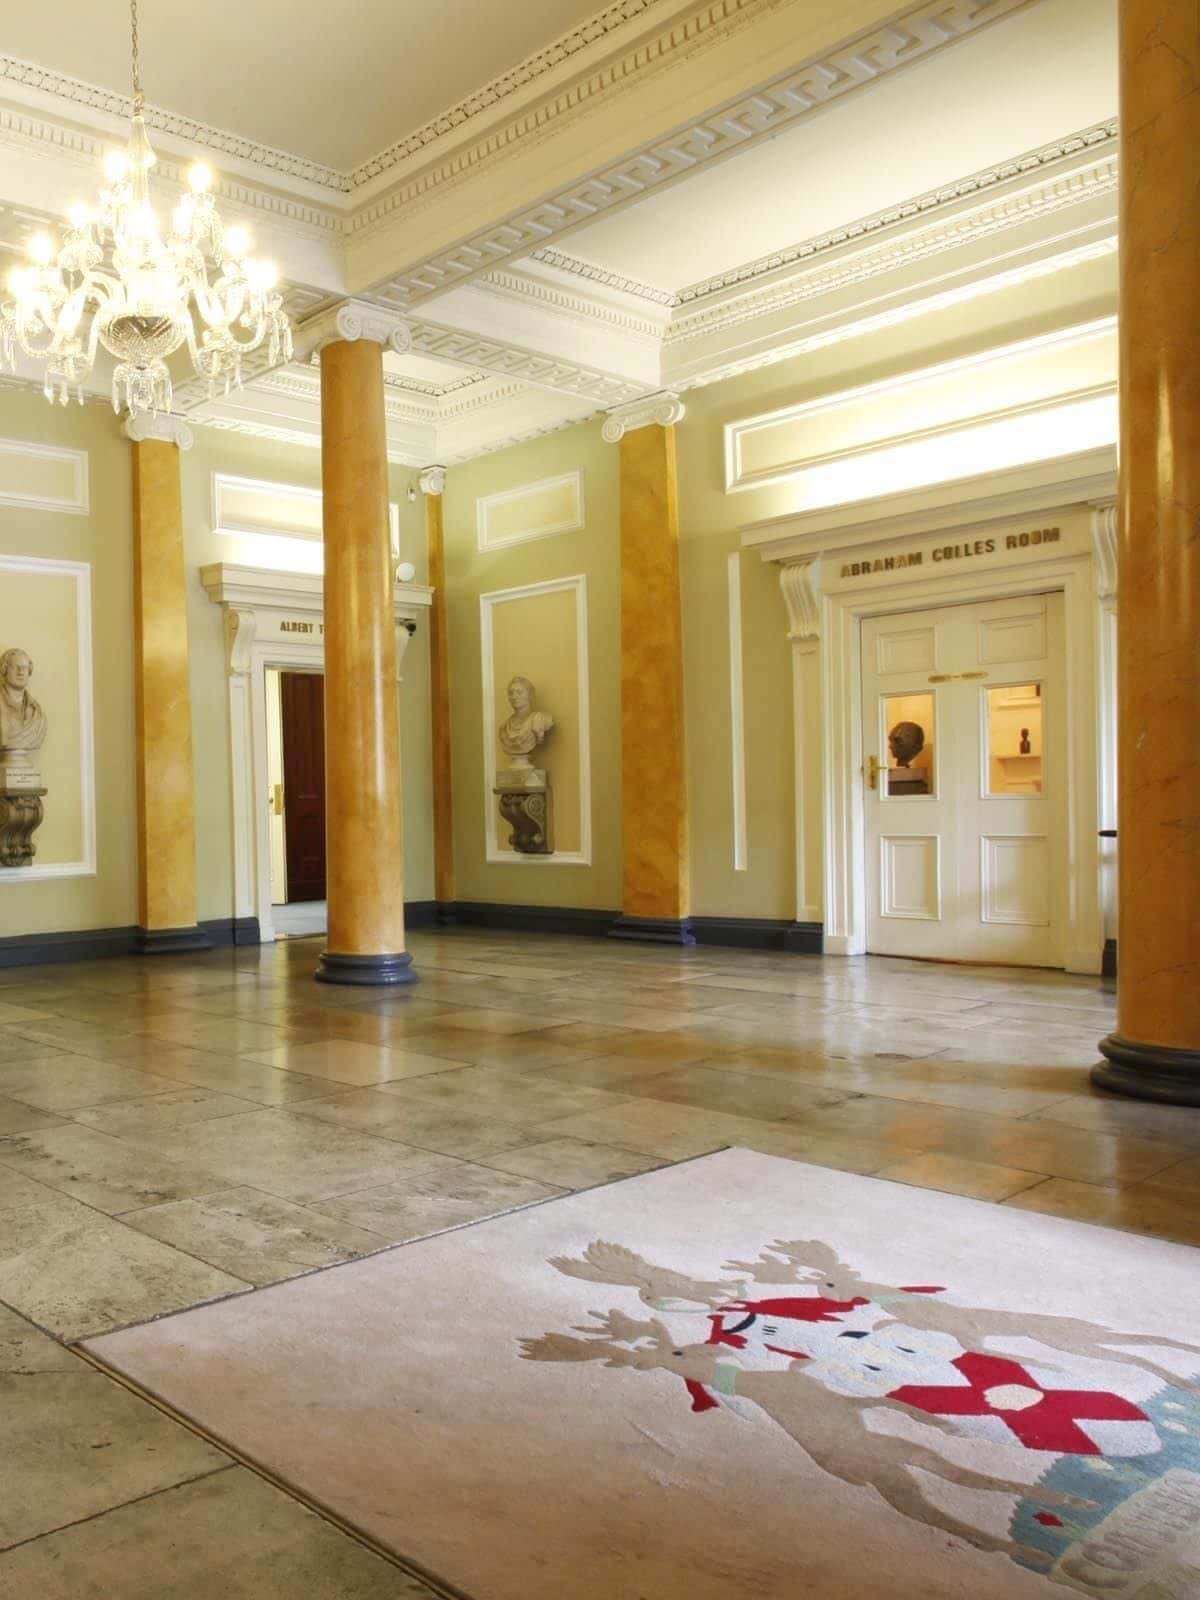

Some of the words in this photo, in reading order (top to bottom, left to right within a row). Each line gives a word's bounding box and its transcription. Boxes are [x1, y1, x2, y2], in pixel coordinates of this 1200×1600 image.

[840, 551, 923, 578] ABRAHAM
[932, 539, 995, 562] COLLES
[1005, 527, 1061, 550] ROOM
[280, 621, 313, 634] ALBERT
